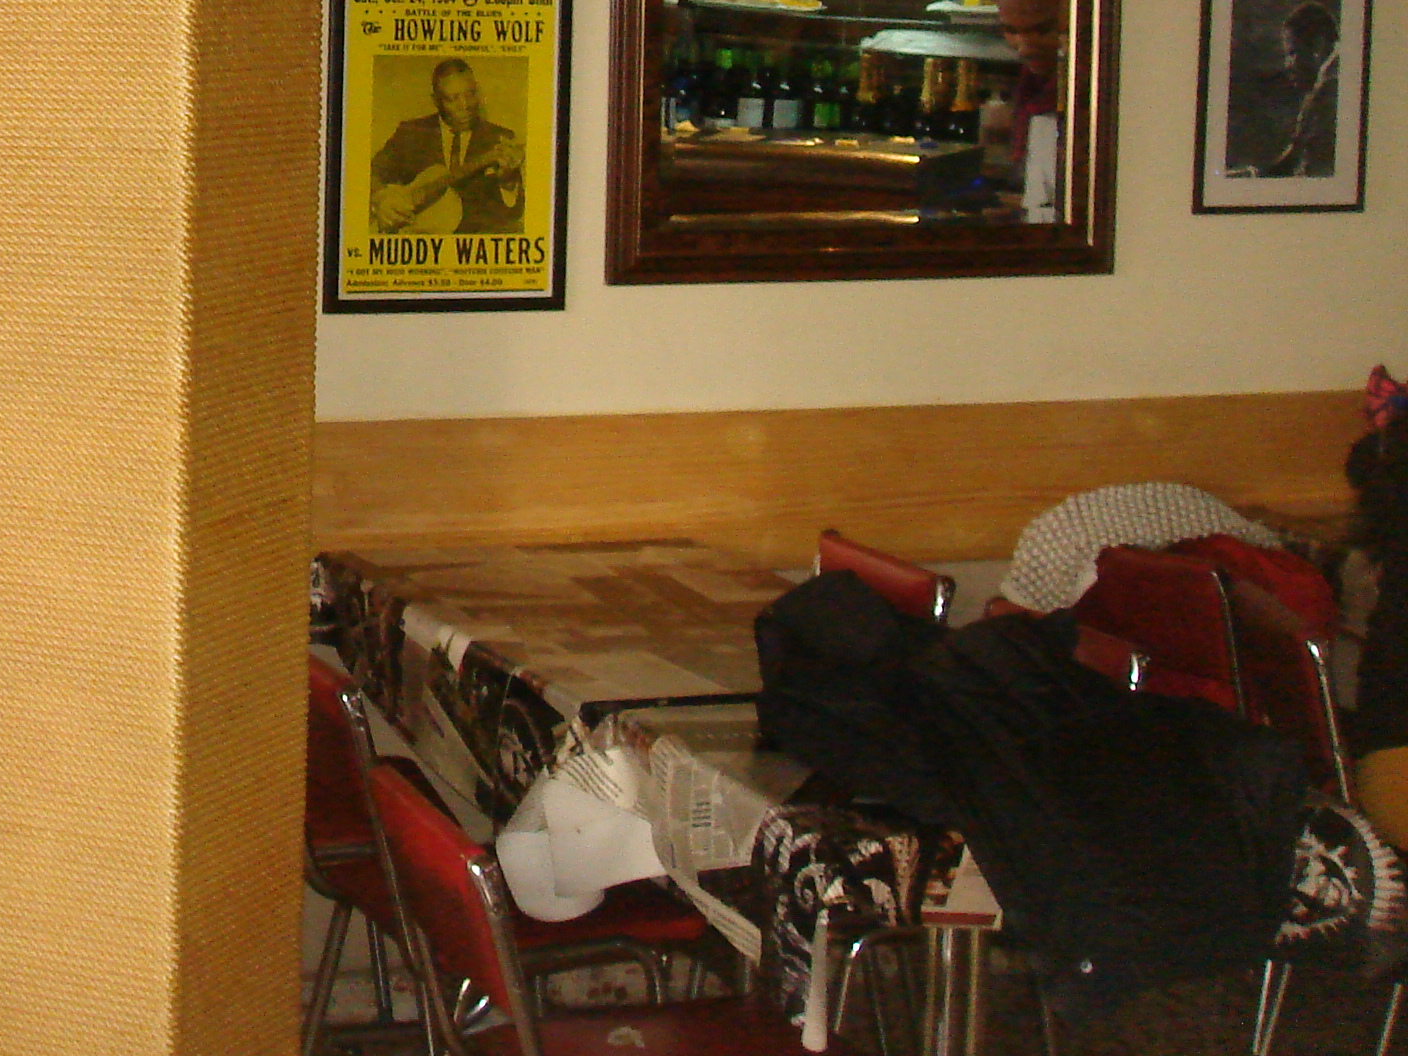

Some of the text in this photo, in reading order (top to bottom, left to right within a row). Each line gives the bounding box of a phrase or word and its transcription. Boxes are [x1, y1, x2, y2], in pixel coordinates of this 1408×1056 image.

[405, 8, 437, 17] BATTLE
[456, 9, 472, 17] THE
[393, 18, 482, 43] HOWLING
[494, 20, 545, 43] WOLF
[369, 238, 443, 265] MUDDY
[456, 237, 545, 265] WATERS
